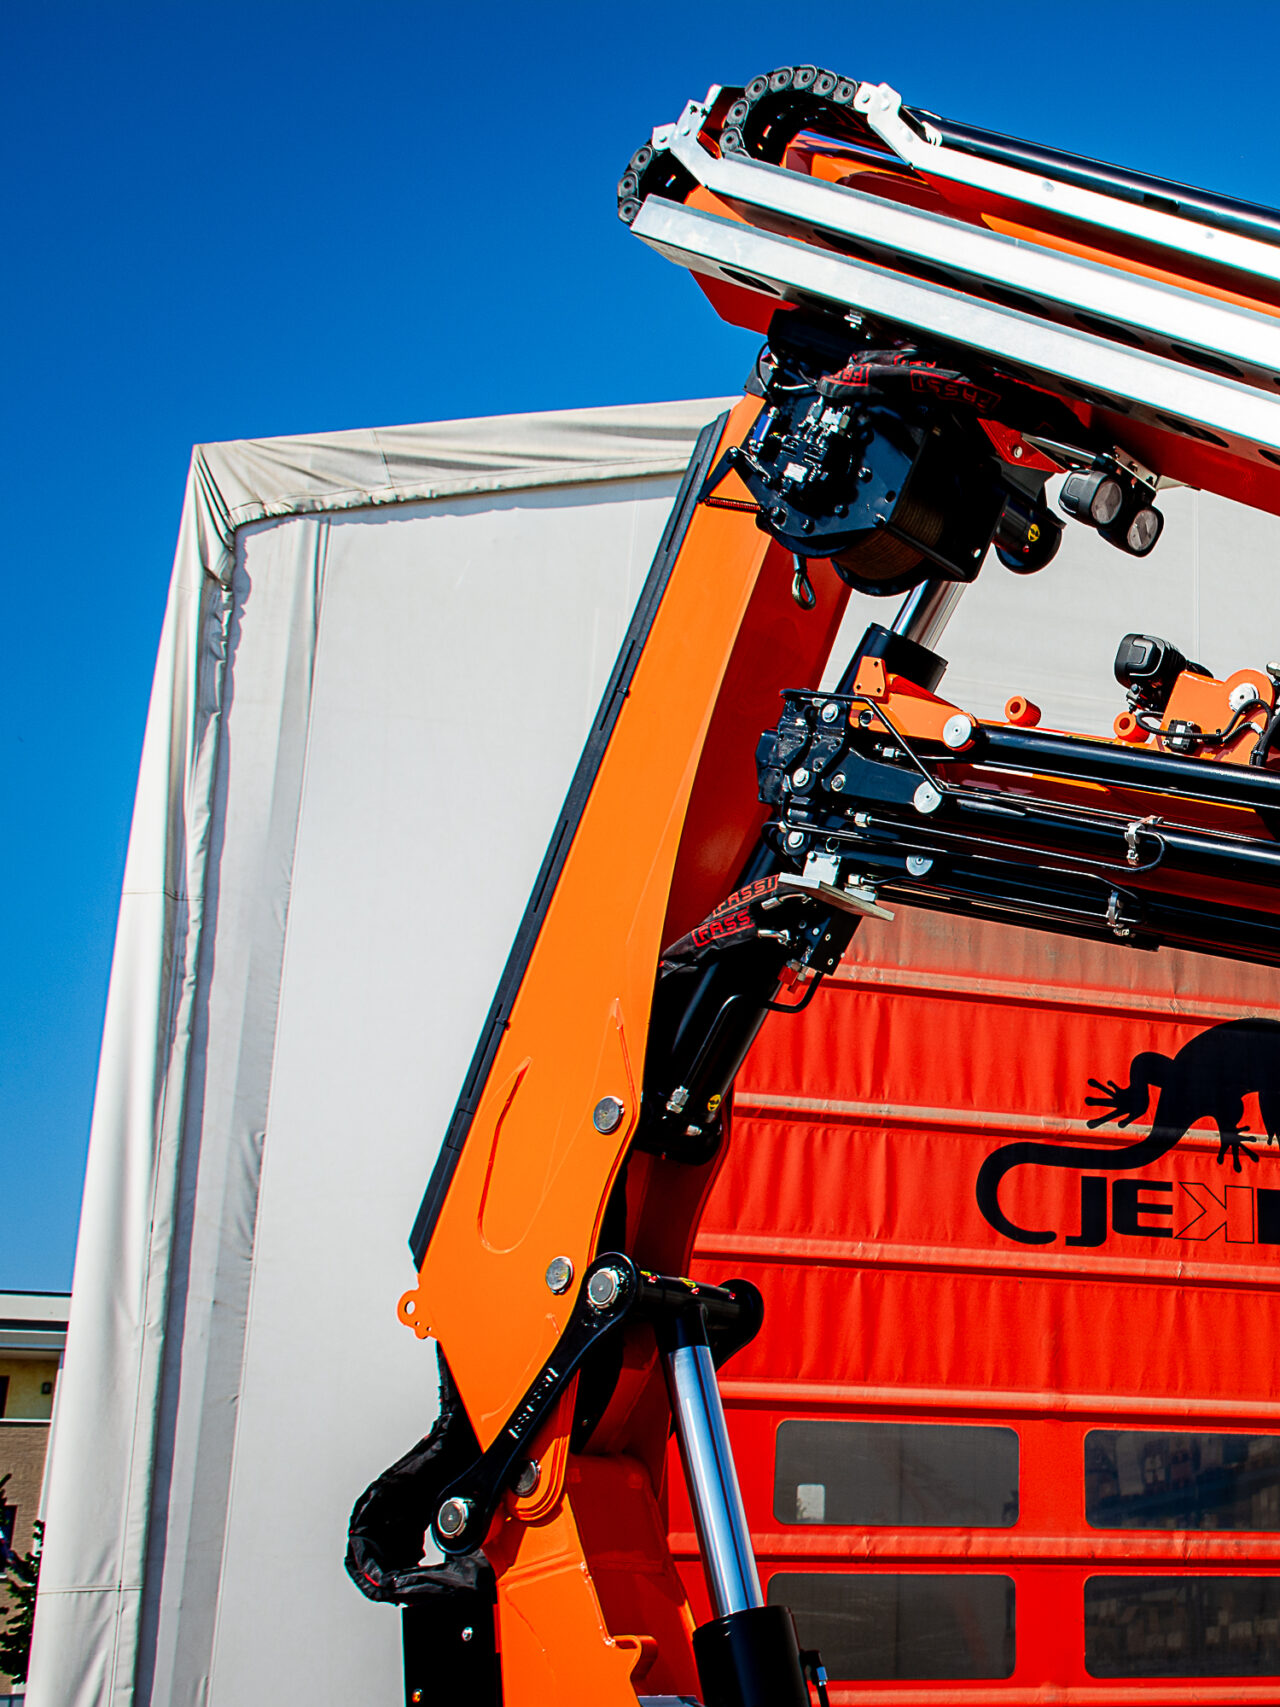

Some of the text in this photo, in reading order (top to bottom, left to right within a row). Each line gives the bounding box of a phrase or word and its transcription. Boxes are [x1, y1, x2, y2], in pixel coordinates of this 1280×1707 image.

[917, 375, 992, 411] FASSI
[717, 877, 772, 911] FASSI
[697, 909, 751, 941] FASS
